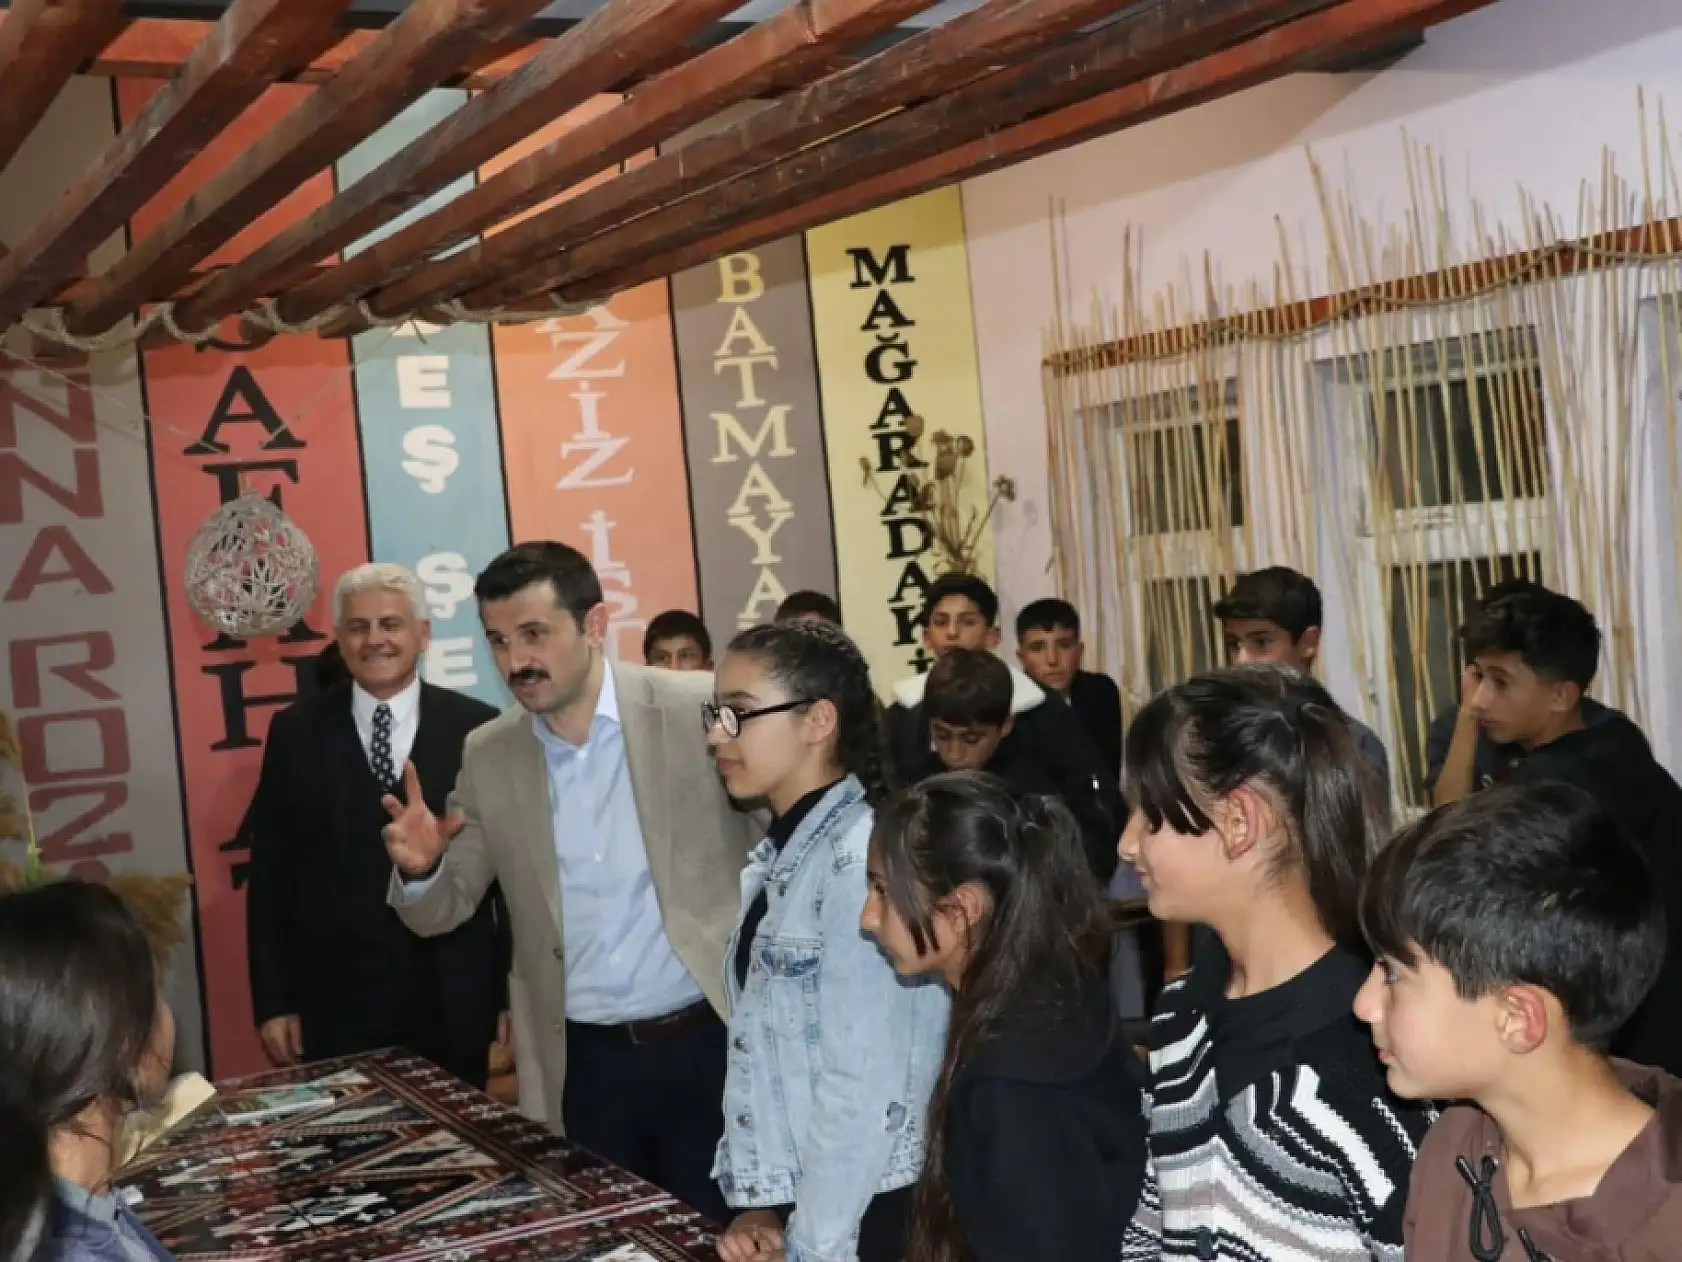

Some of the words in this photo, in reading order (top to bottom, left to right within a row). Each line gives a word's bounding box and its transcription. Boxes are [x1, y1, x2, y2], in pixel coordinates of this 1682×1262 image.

[0, 347, 114, 601] NNA
[389, 318, 460, 493] EŞ
[709, 252, 796, 630] BATMAYA
